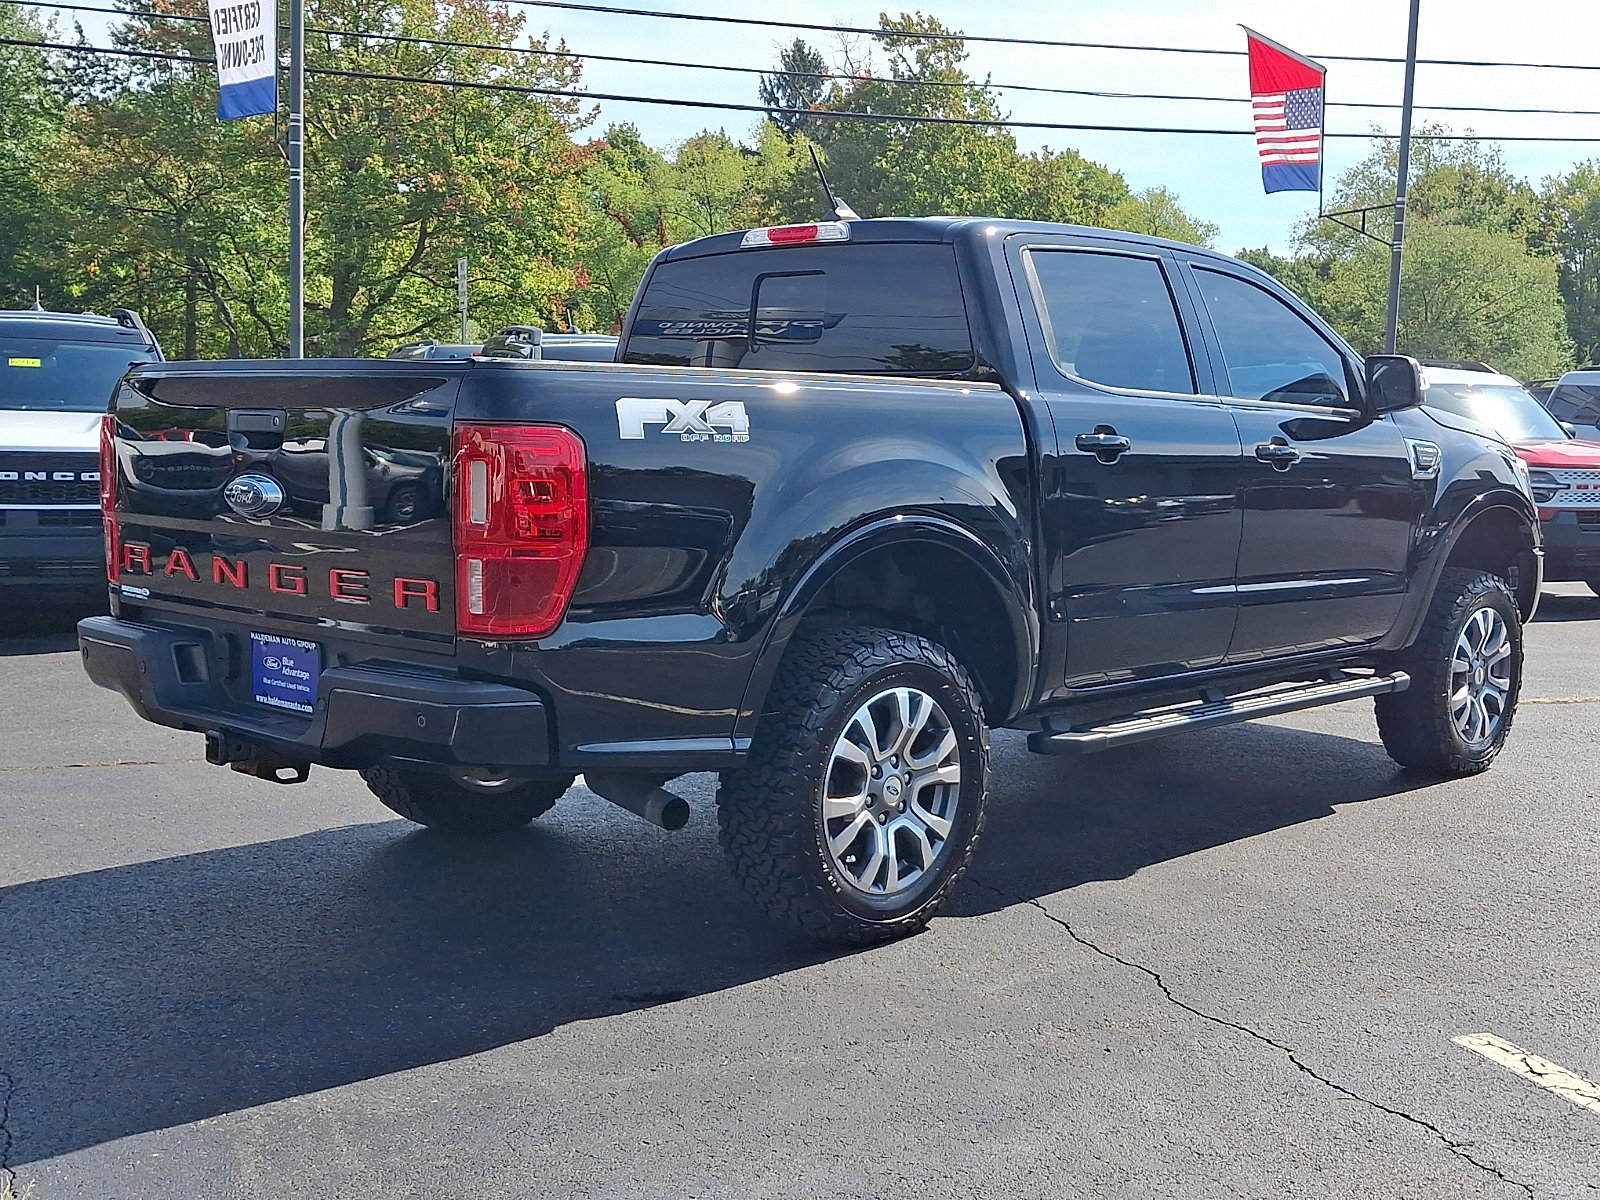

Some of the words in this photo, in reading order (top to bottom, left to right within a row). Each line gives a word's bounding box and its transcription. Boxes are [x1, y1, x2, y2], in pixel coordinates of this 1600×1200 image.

[615, 397, 750, 440] FX4
[681, 434, 710, 442] OFF
[713, 434, 750, 443] ROAD
[225, 485, 254, 504] Ford
[122, 543, 441, 613] RANGER
[281, 638, 296, 647] AUTO
[296, 641, 316, 650] GROUP
[282, 656, 295, 667] Blue
[282, 666, 310, 680] Advantage
